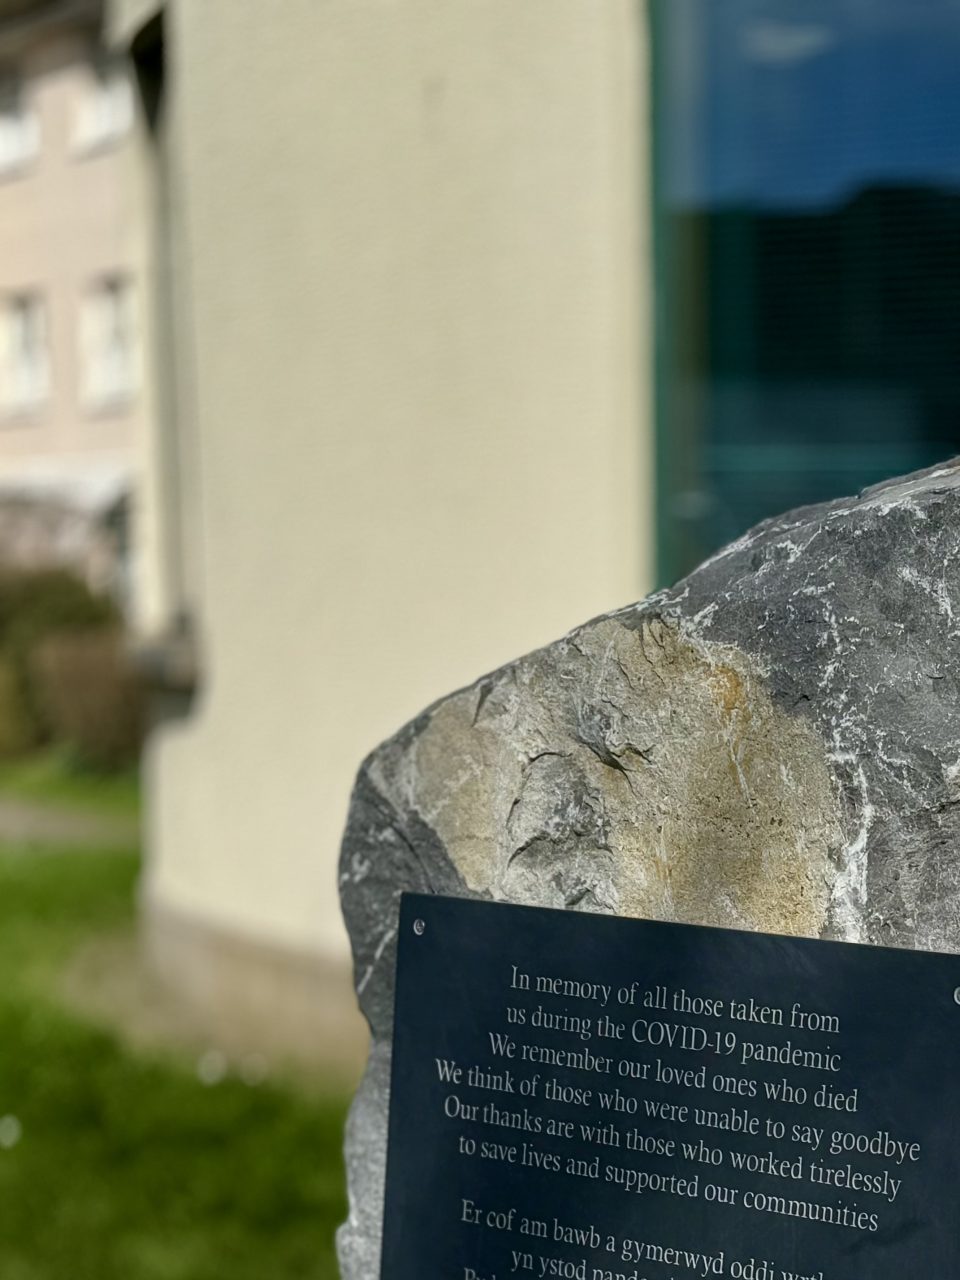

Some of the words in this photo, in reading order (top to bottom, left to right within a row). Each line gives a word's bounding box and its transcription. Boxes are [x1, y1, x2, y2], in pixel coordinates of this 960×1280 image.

[506, 1007, 526, 1025] us
[531, 1005, 592, 1041] during
[597, 1015, 626, 1040] the
[631, 1019, 737, 1056] COVID-19
[740, 1040, 842, 1072] pandemic
[509, 964, 530, 991] In
[535, 976, 612, 1008] memory
[617, 981, 640, 1005] of
[643, 985, 668, 1010] all
[673, 988, 724, 1018] those
[729, 998, 784, 1026] taken
[789, 1002, 840, 1034] from
[435, 1057, 463, 1085] We
[467, 1065, 515, 1094] think
[519, 1074, 541, 1097] of
[545, 1078, 593, 1107] those
[598, 1088, 638, 1114] who
[643, 1099, 689, 1123] were
[694, 1107, 760, 1135] unable
[765, 1117, 786, 1139] to
[791, 1124, 825, 1151] say
[829, 1130, 921, 1165] goodbye
[488, 1031, 516, 1059] We
[521, 1044, 614, 1074] remember
[618, 1059, 651, 1080] our
[655, 1058, 707, 1089] loved
[712, 1074, 758, 1098] ones
[763, 1078, 808, 1105] who
[813, 1084, 858, 1113] died
[444, 1095, 480, 1121] Our
[483, 1102, 543, 1133] thanks
[546, 1119, 575, 1139] are
[579, 1120, 622, 1148] with
[625, 1128, 676, 1157] those
[680, 1139, 723, 1166] who
[729, 1151, 803, 1180] worked
[809, 1158, 903, 1203] tirelessly
[459, 1135, 476, 1156] to
[480, 1141, 517, 1163] save
[520, 1142, 561, 1172] lives
[565, 1156, 600, 1179] and
[604, 1164, 699, 1198] supported
[704, 1183, 739, 1206] our
[743, 1191, 879, 1232] communities
[460, 1198, 483, 1224] Er
[486, 1208, 517, 1231] cof
[519, 1217, 548, 1238] am
[553, 1217, 601, 1249] bawb
[605, 1235, 616, 1253] a
[620, 1239, 725, 1278] gymerwyd
[510, 1250, 535, 1272] yn
[538, 1256, 587, 1280] ystod
